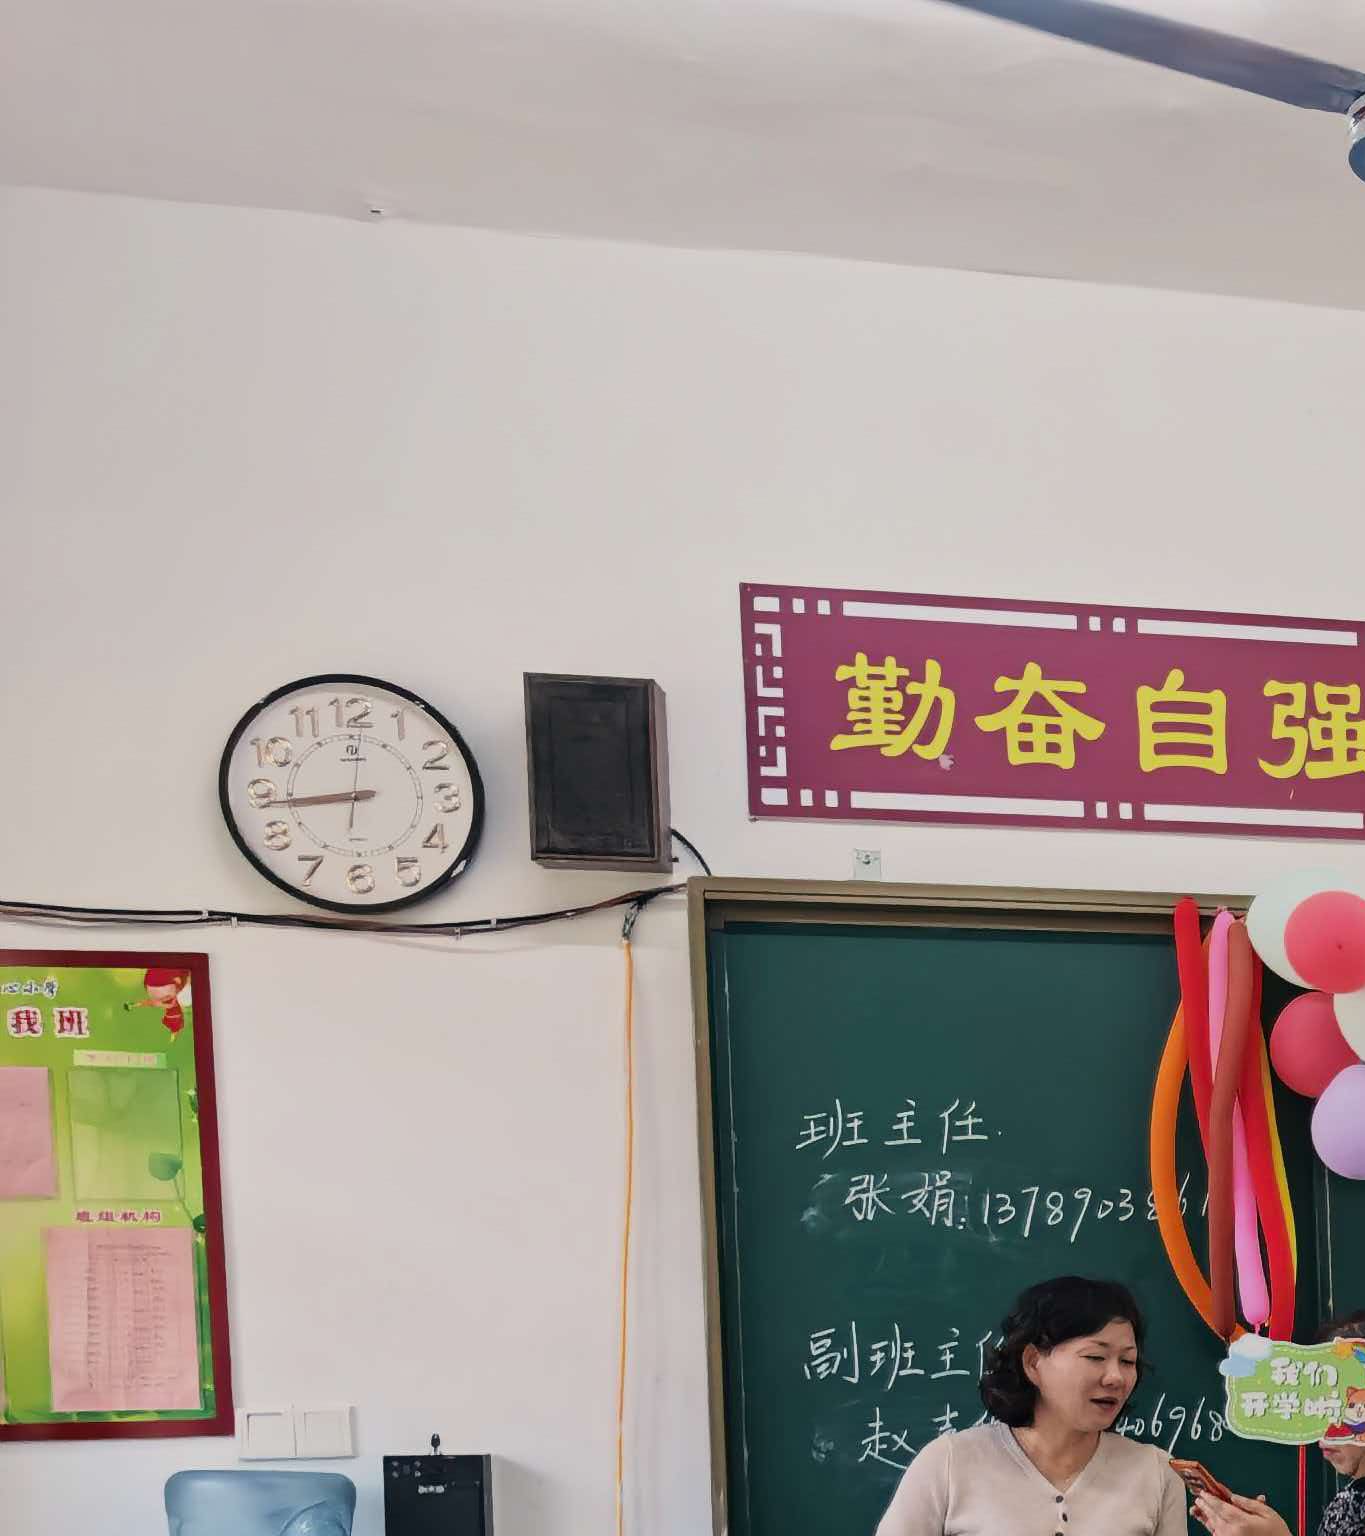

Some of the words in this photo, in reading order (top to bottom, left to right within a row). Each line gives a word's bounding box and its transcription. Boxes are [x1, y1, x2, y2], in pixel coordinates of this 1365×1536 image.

[290, 706, 319, 737] 11
[328, 698, 374, 729] 12
[391, 709, 406, 741] 1
[251, 737, 292, 768] 10
[422, 740, 450, 771] 2
[248, 778, 276, 809] 9
[435, 783, 462, 813] 3
[264, 820, 292, 851] 8
[422, 823, 448, 854] 4
[298, 855, 324, 887] 7
[347, 864, 375, 894] 6
[397, 857, 421, 887] 5
[1270, 1357, 1338, 1387] 我们
